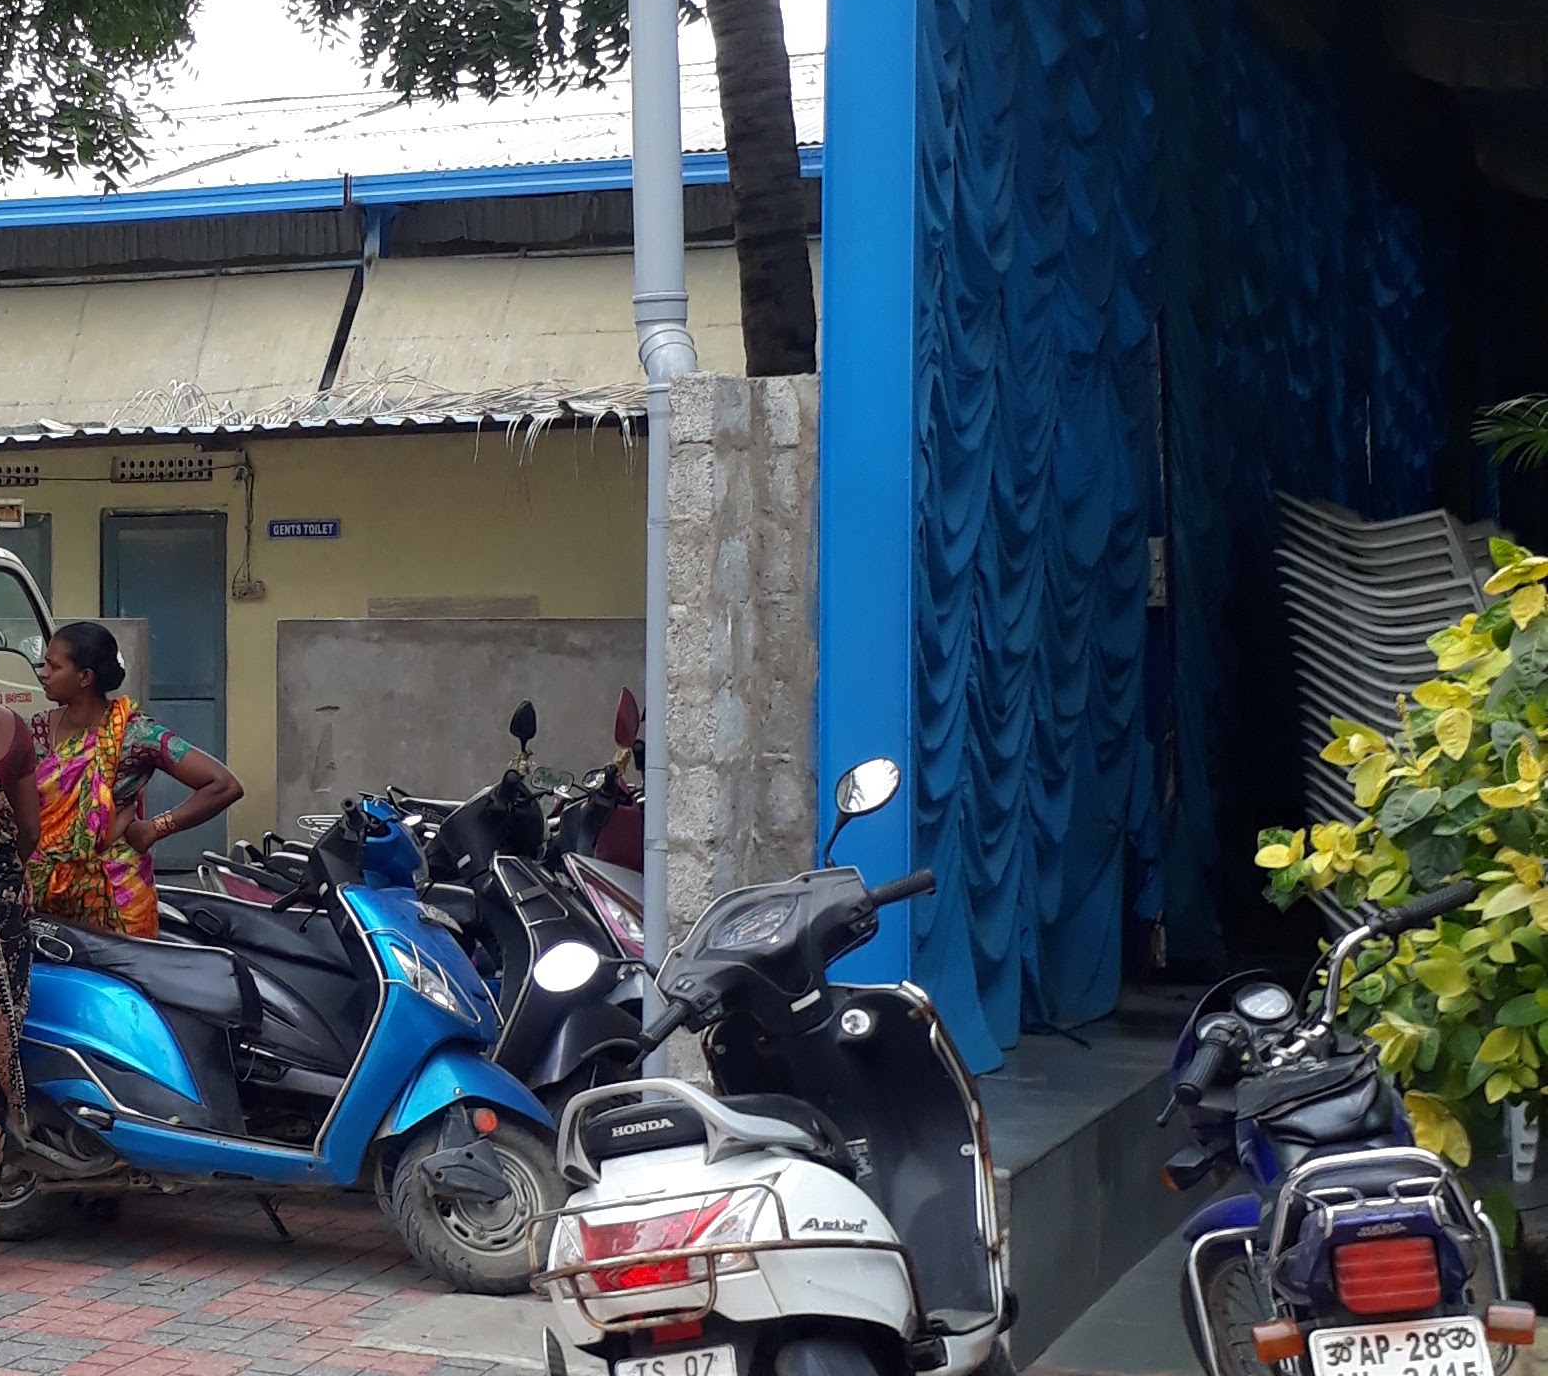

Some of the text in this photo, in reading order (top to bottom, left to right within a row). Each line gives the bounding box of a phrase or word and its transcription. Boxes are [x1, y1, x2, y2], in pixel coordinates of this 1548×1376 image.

[273, 524, 334, 536] GENTS TOILET
[611, 1118, 675, 1138] HONDA
